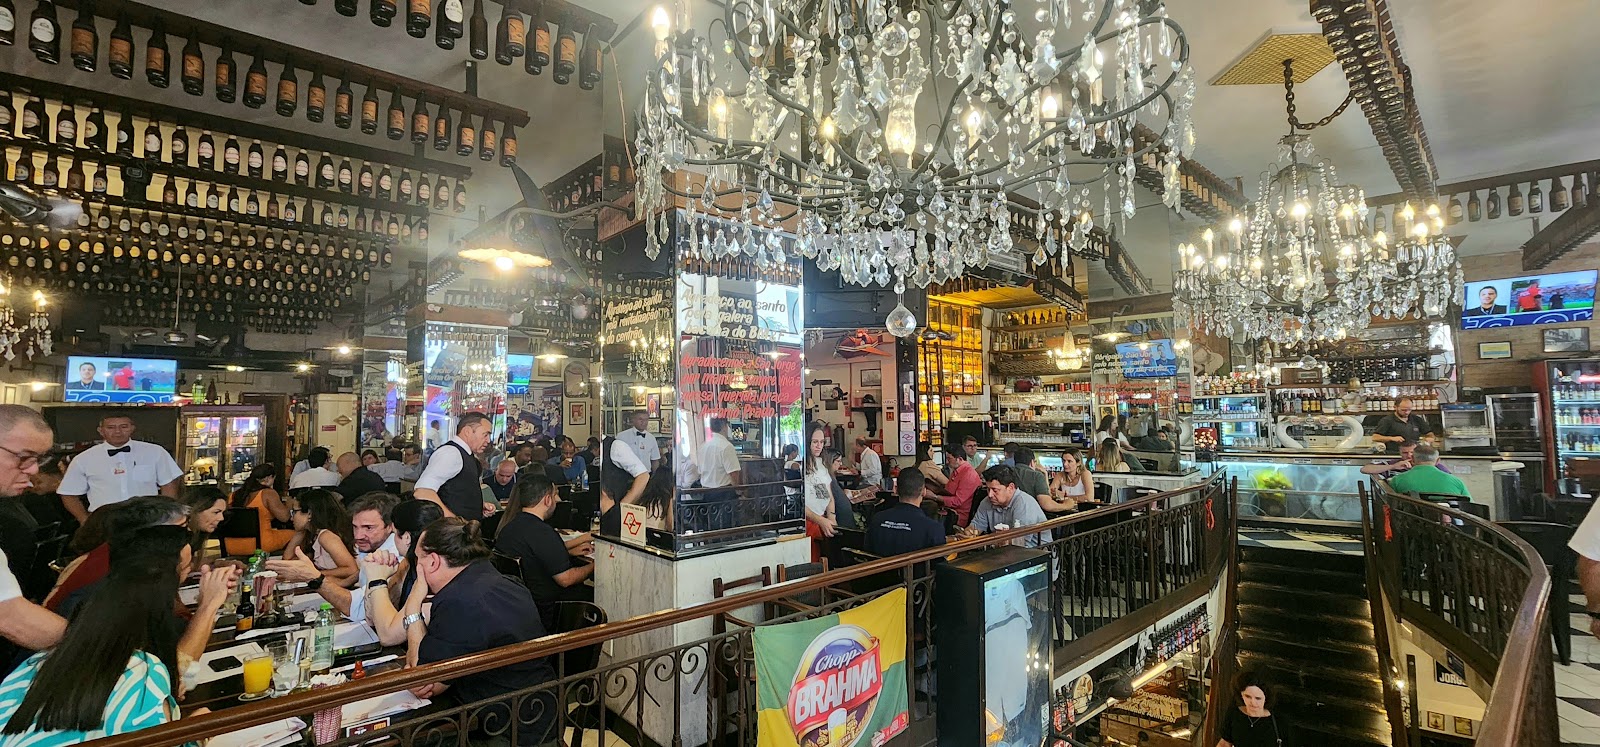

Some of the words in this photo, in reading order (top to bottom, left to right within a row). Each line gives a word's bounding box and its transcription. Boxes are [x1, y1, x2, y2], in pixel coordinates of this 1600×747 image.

[756, 299, 786, 313] santo
[719, 309, 754, 325] galera
[606, 330, 615, 345] do
[732, 324, 746, 338] do
[681, 352, 745, 368] Agradecemos
[754, 355, 771, 370] São
[771, 358, 797, 371] Jorge
[1130, 359, 1150, 367] santo
[815, 649, 859, 674] Chopp
[795, 654, 877, 724] BRAHMA
